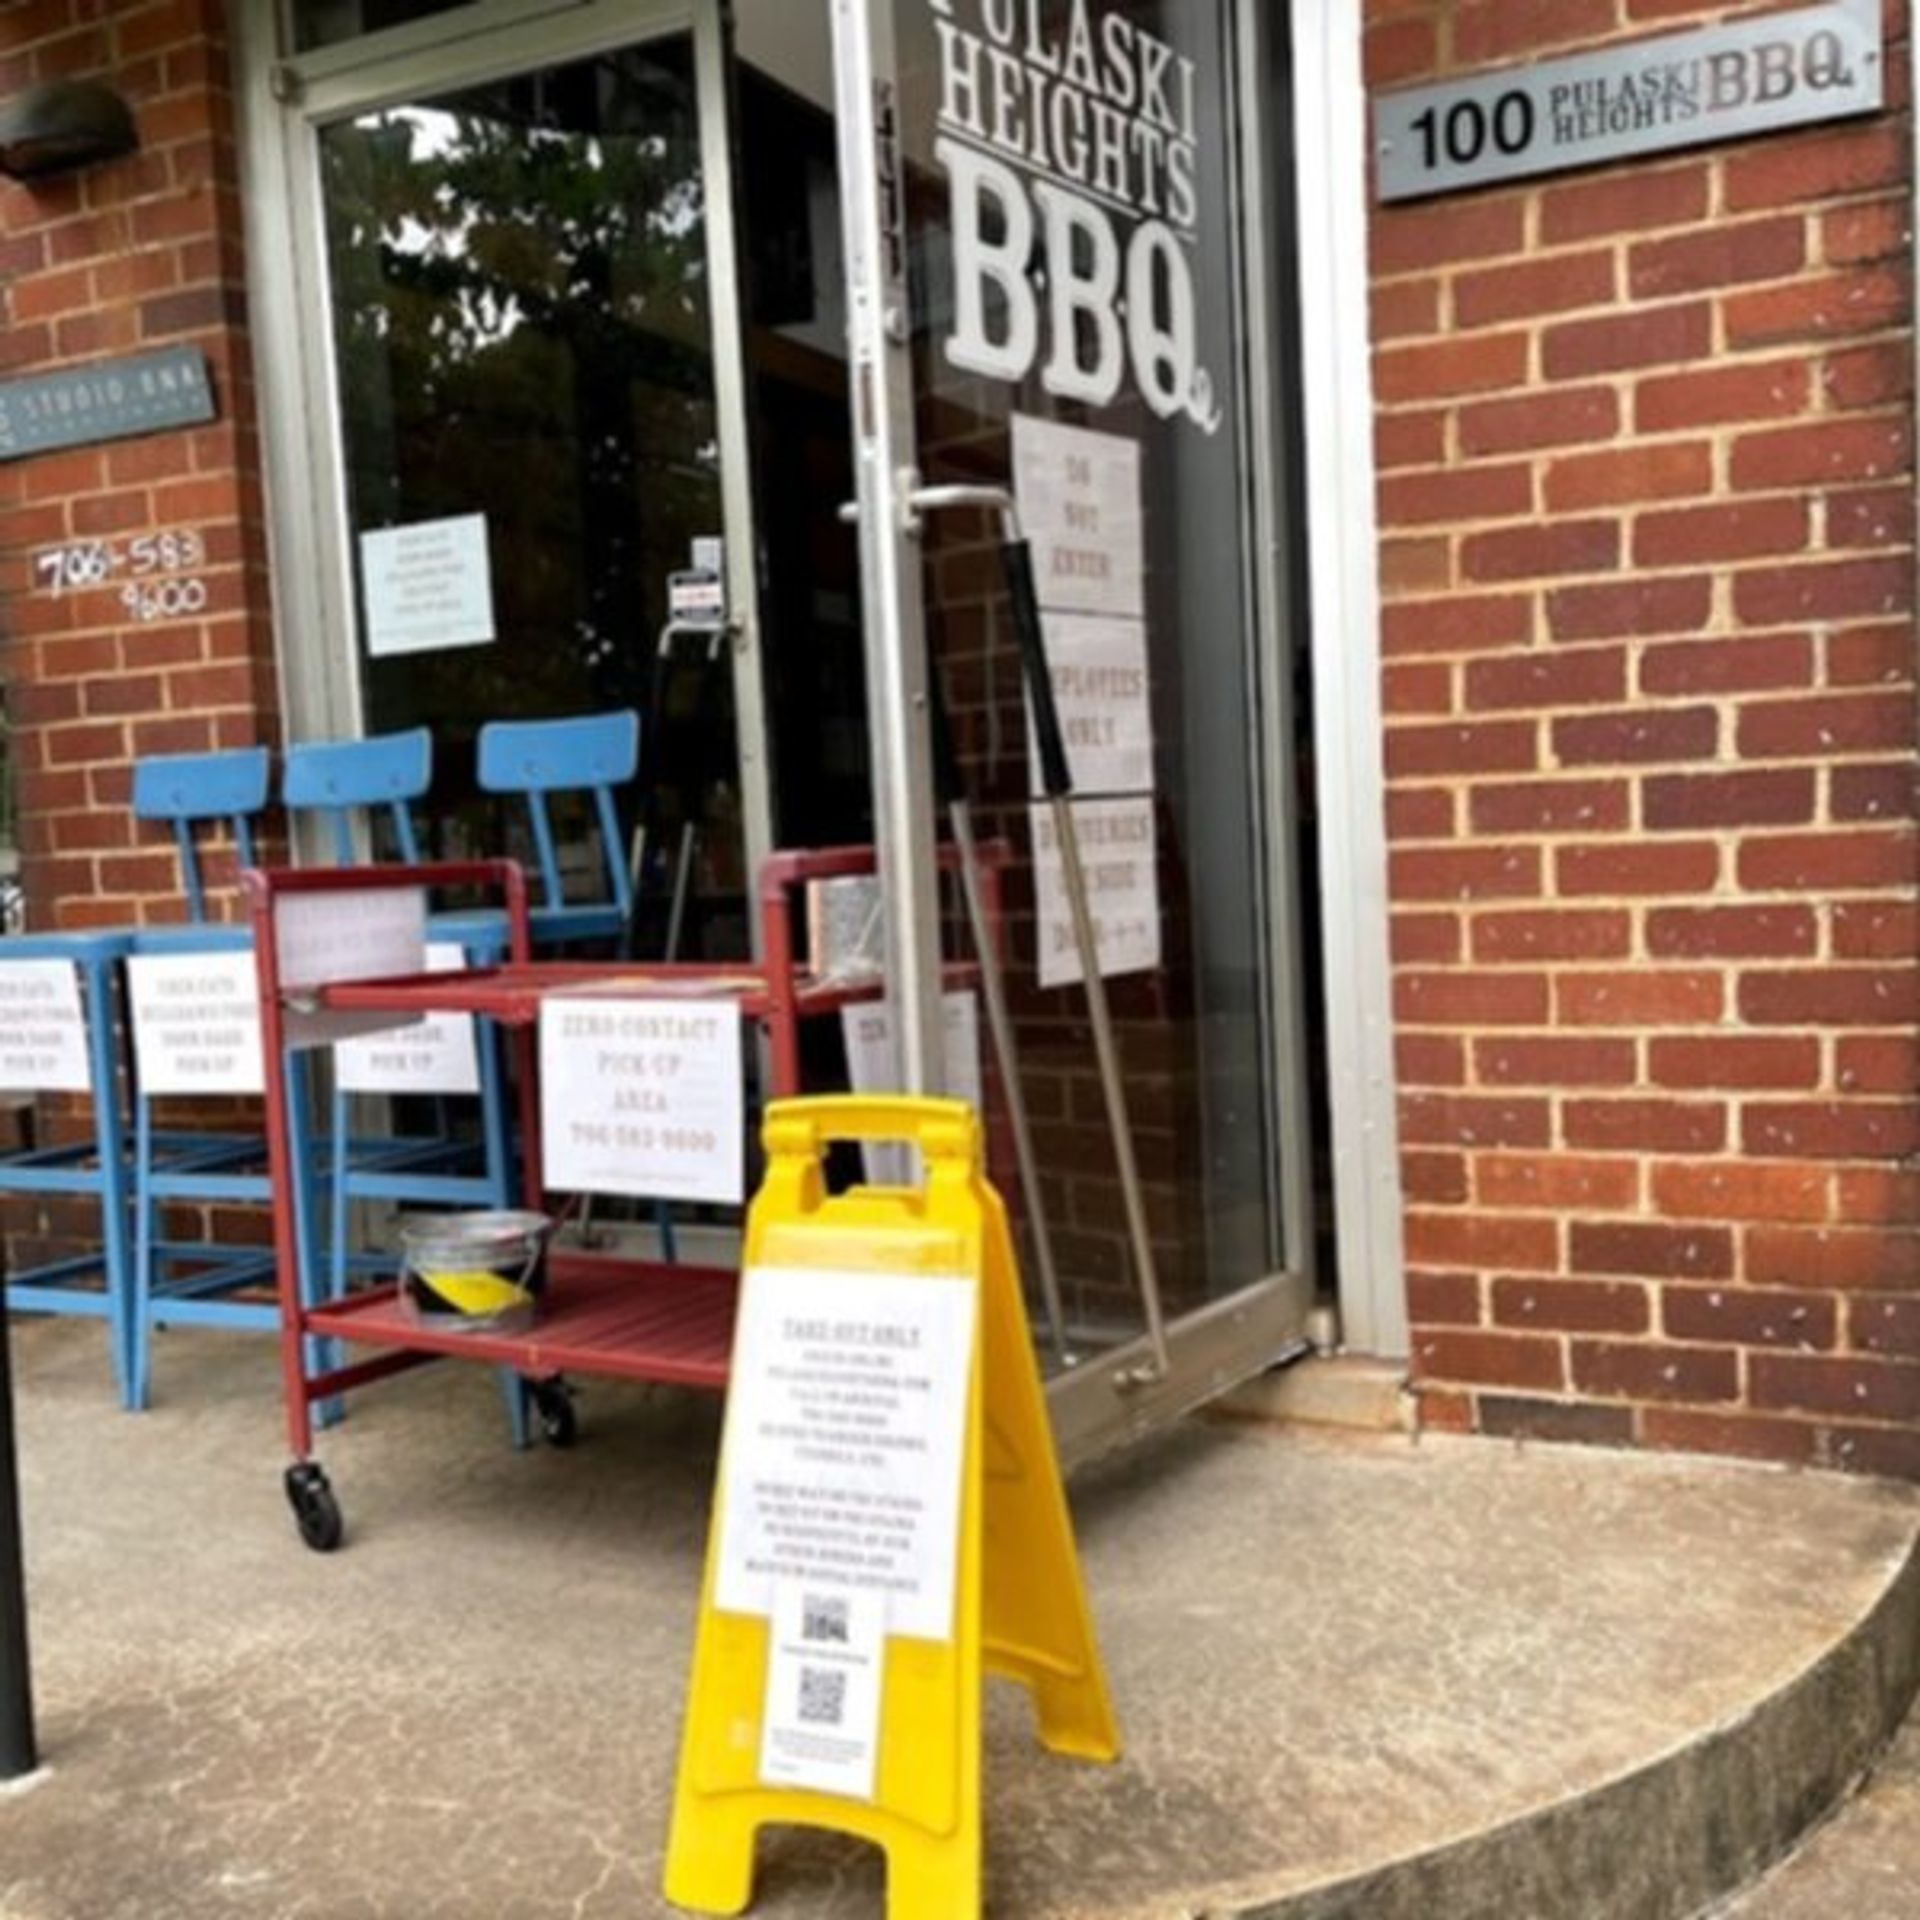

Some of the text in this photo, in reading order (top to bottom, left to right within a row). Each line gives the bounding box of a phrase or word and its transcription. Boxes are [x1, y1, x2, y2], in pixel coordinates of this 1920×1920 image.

[1549, 59, 1700, 114] PULASKI
[1553, 94, 1700, 145] HEIGHTS
[934, 18, 1197, 227] HEIGHTS
[1410, 89, 1535, 169] 100
